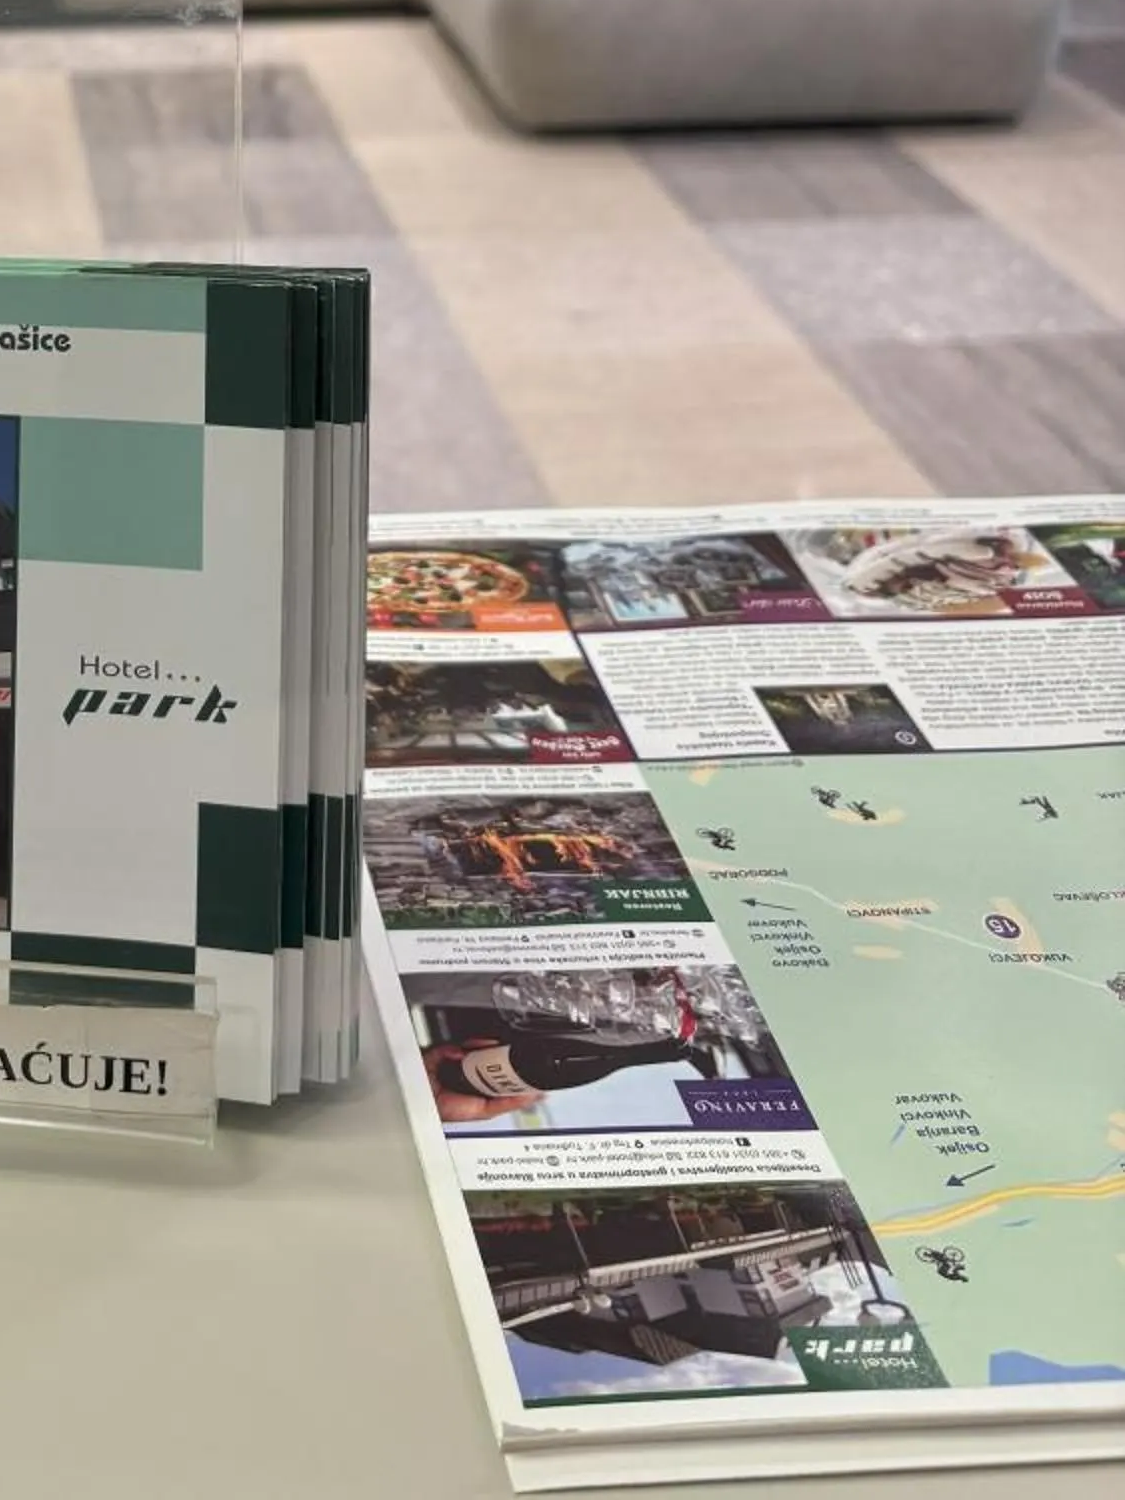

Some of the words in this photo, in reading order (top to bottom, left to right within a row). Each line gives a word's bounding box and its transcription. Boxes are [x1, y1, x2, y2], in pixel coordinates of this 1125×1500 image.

[62, 684, 238, 728] park
[602, 888, 691, 899] RIBNJAK
[846, 907, 931, 918] STIPANOVCI
[987, 918, 1016, 934] 15
[749, 931, 813, 942] Vinkovci
[987, 953, 1073, 963] VUKOJEVCI
[894, 1092, 962, 1106] Vukovar
[693, 1099, 801, 1114] FERAVINO
[900, 1108, 972, 1124] Vinkovci
[915, 1125, 980, 1139] Baranja
[934, 1141, 990, 1156] Osijek
[804, 1331, 914, 1362] park
